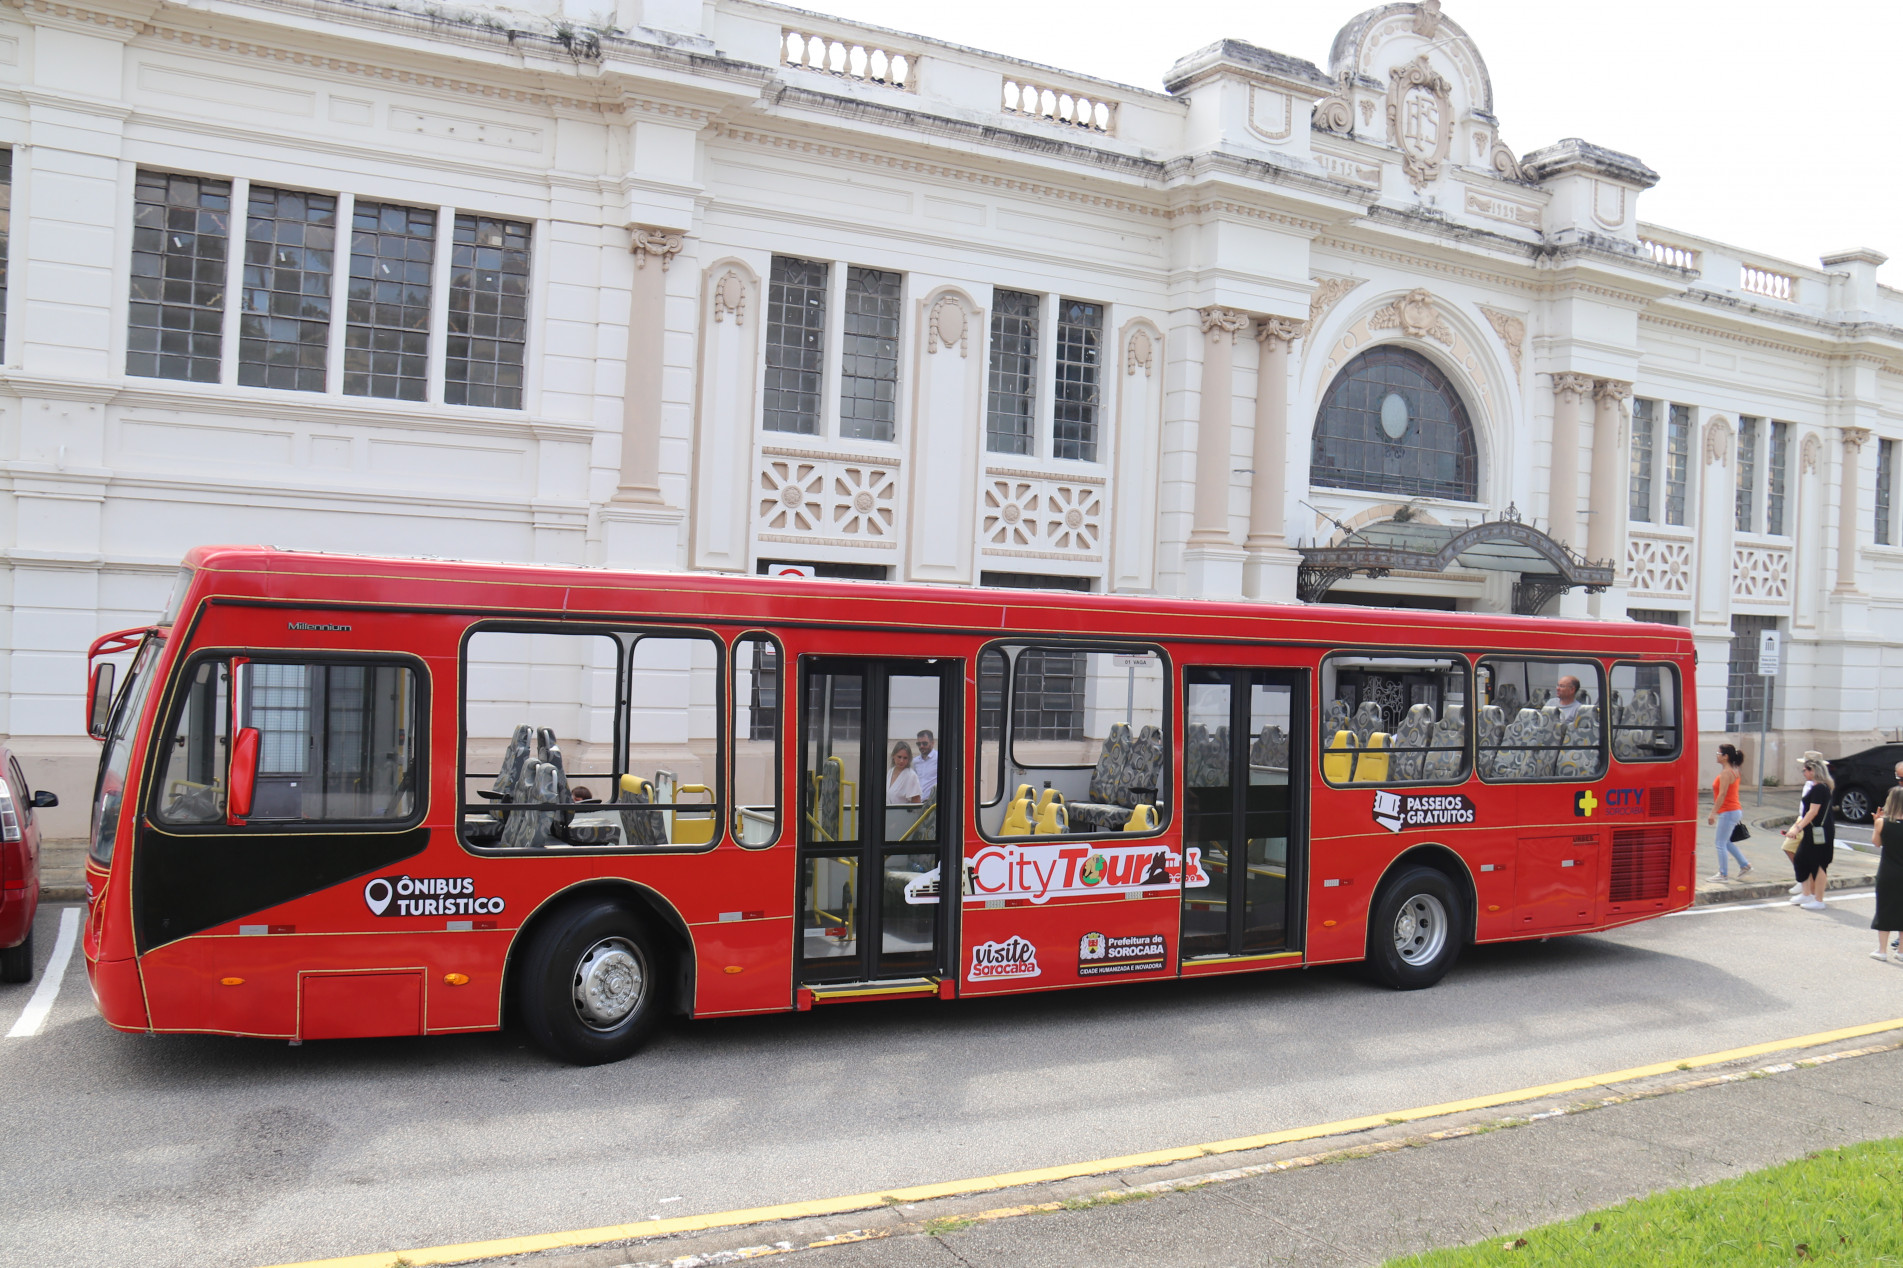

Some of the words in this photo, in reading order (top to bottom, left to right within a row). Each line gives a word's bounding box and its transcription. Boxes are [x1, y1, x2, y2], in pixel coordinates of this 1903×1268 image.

[288, 622, 352, 631] Millennium
[1407, 797, 1462, 811] PASSEIOS
[1605, 788, 1644, 806] CITY
[1407, 809, 1474, 824] GRATUITOS
[397, 875, 474, 896] ÔNIBUS
[397, 894, 505, 916] TURÍSTICO
[1108, 936, 1150, 947] Prefeitura
[1152, 935, 1163, 943] de
[975, 939, 1034, 964] visite
[1108, 945, 1164, 957] SOROCABA
[973, 960, 1035, 976] Sorocaba
[1099, 965, 1130, 973] HUMANIZADA
